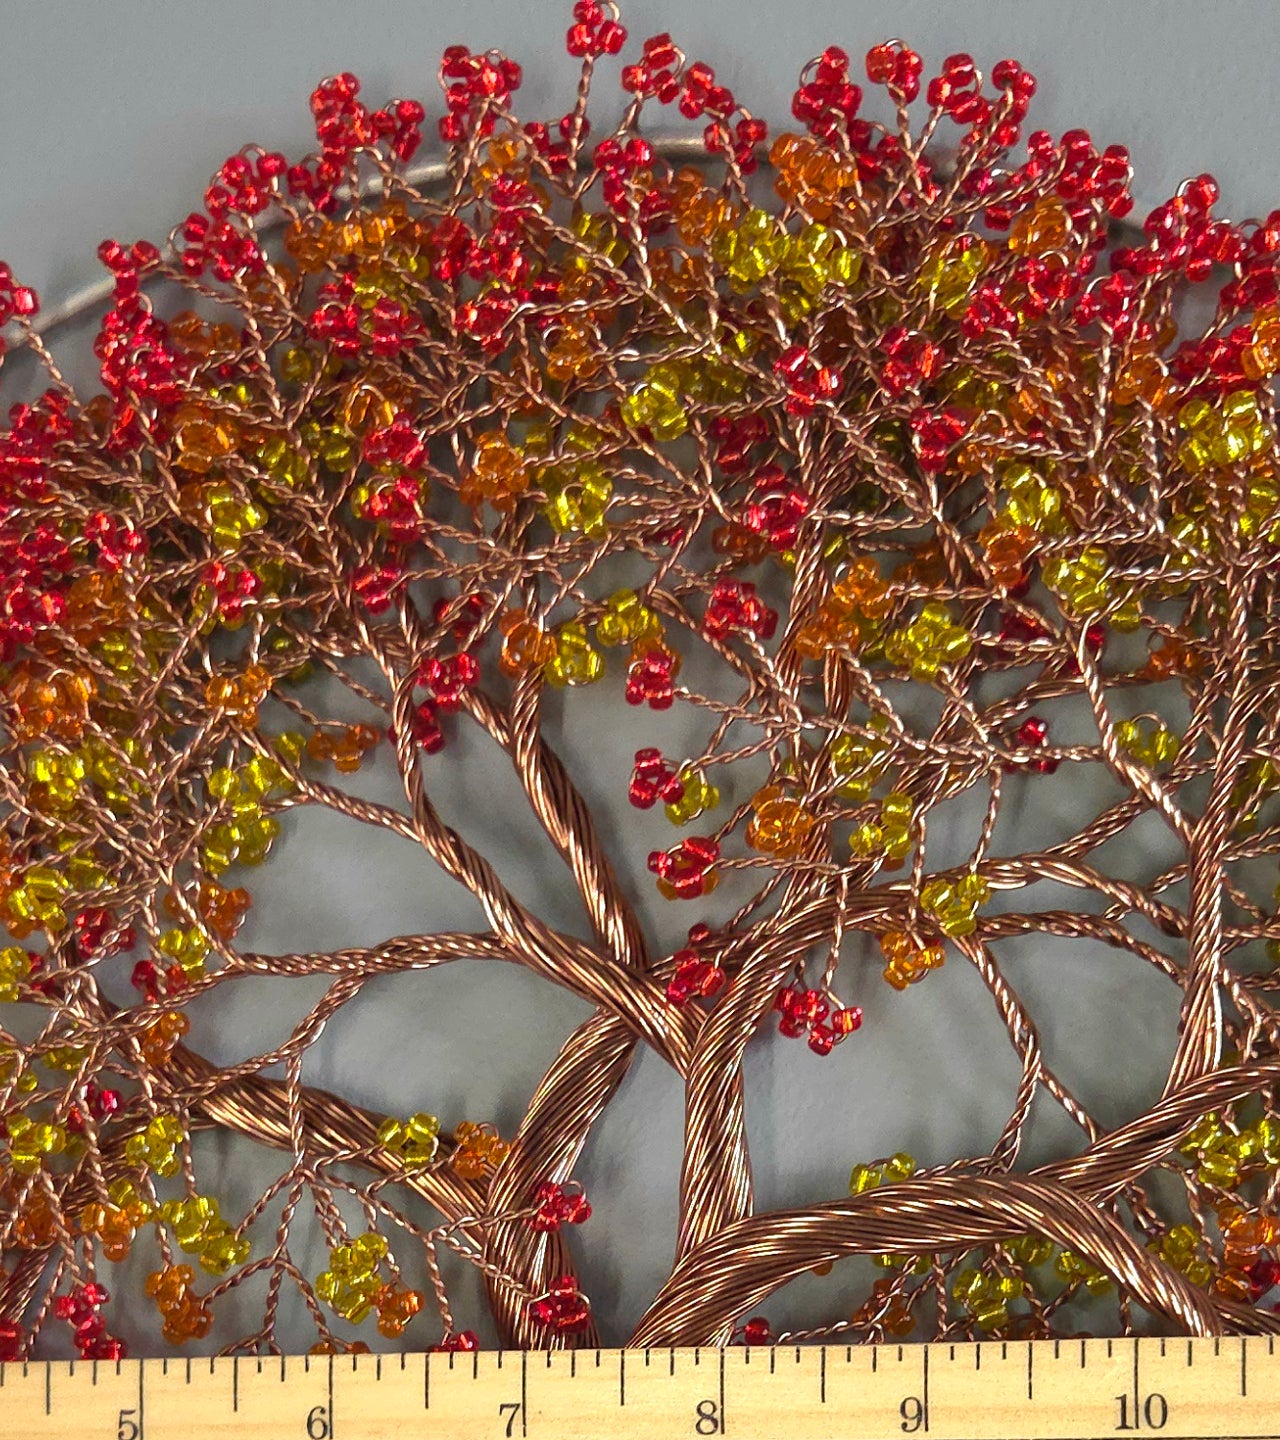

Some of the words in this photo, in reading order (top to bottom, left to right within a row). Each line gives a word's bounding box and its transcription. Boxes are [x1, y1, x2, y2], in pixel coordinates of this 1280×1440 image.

[306, 1406, 328, 1440] 6
[498, 1403, 520, 1437] 7
[695, 1400, 718, 1435] 8
[900, 1397, 922, 1432] 9
[1114, 1394, 1167, 1430] 10
